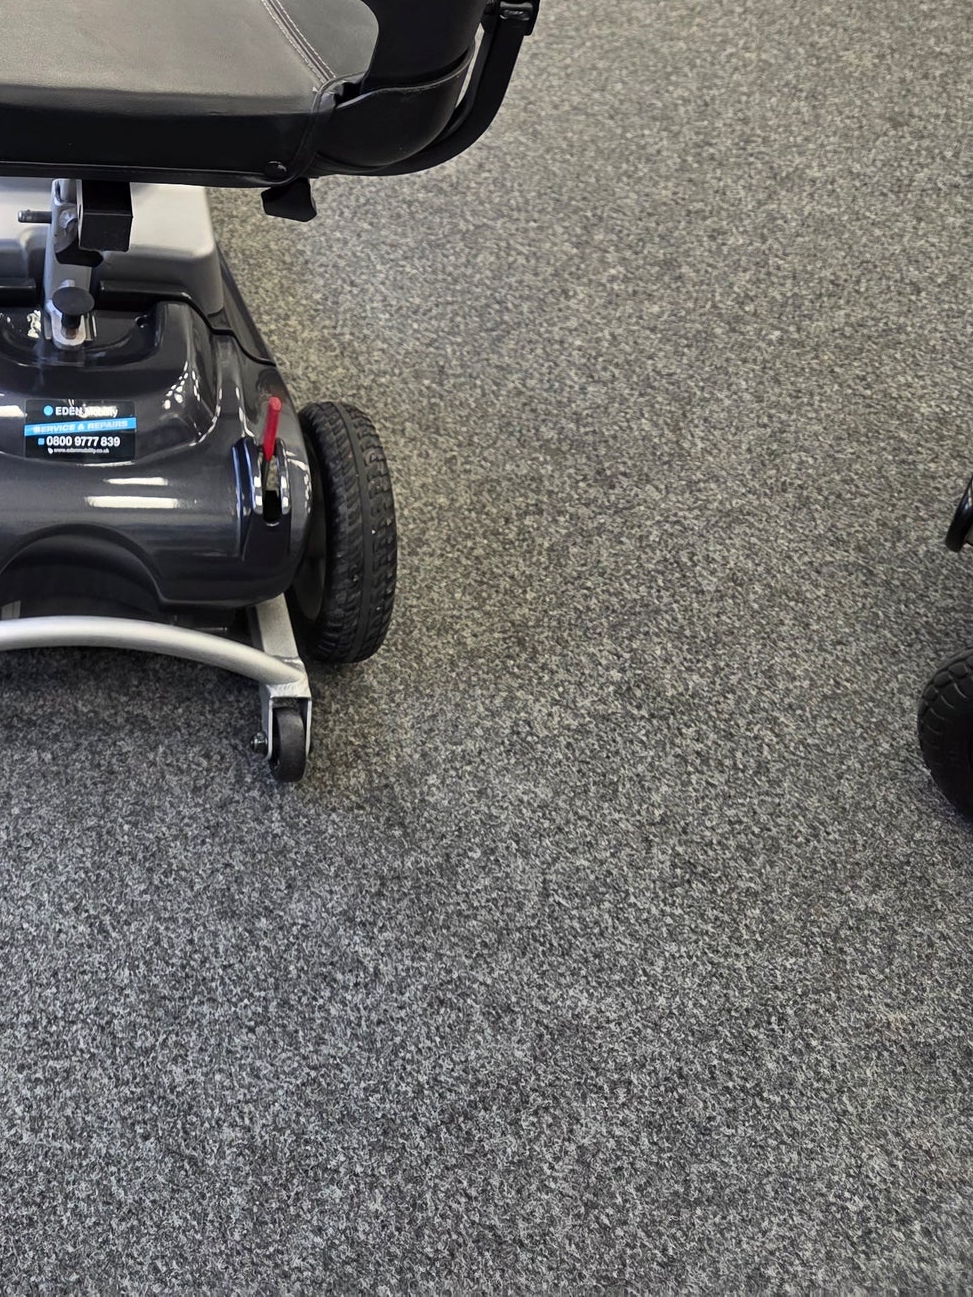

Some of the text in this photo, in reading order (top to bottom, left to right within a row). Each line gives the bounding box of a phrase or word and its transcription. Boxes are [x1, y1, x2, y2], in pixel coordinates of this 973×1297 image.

[55, 406, 83, 416] EDEN
[33, 420, 129, 433] SERVICE & REPAIRS
[45, 435, 121, 447] 0800 9777 839
